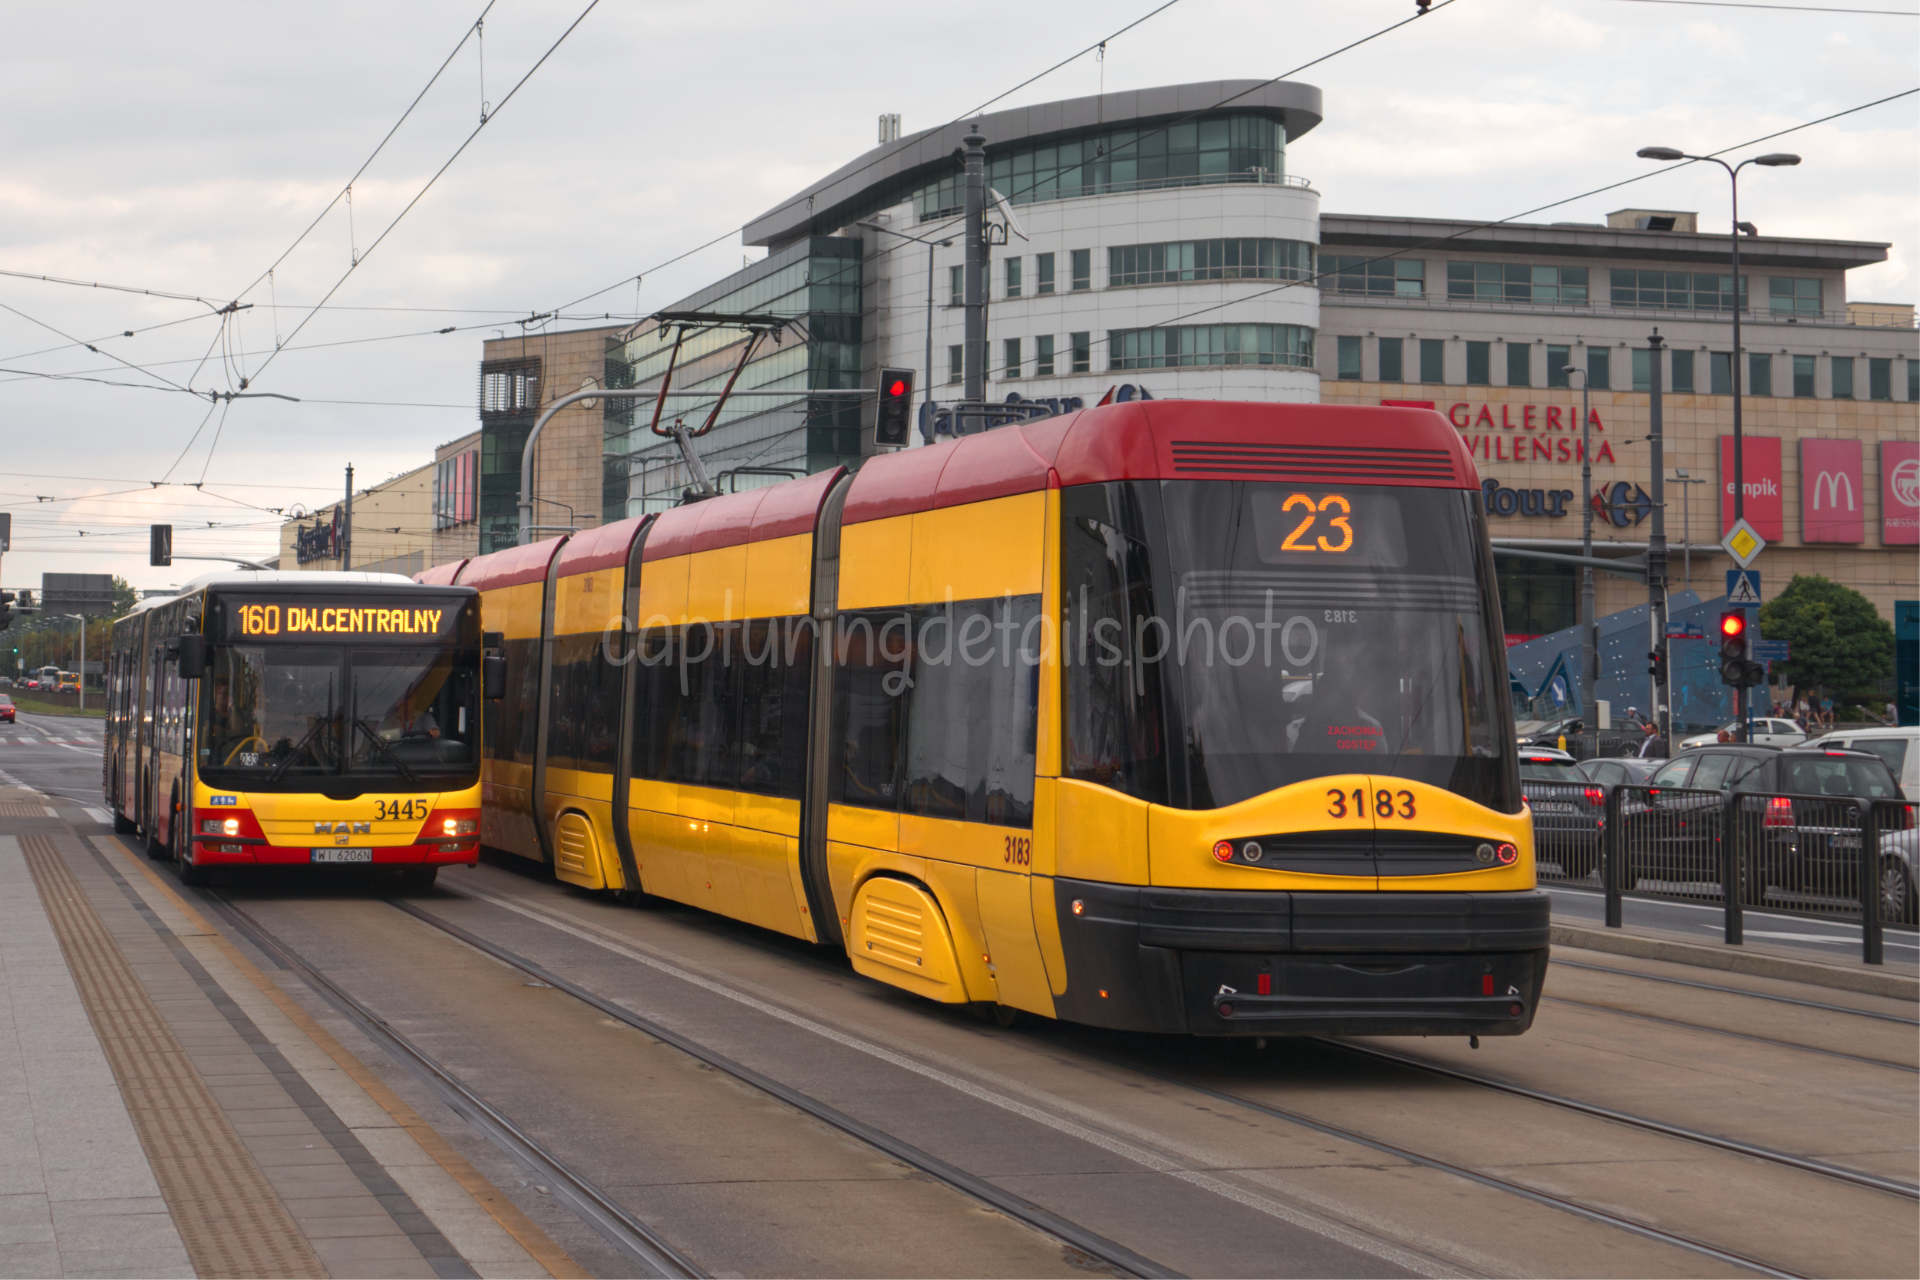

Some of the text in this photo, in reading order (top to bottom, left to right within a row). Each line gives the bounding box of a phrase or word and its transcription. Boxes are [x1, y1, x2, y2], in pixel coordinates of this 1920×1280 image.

[1450, 403, 1604, 431] GALERIA
[1281, 494, 1352, 552] 23
[238, 605, 442, 634] 160 DW.CENTRALNY
[375, 799, 428, 821] 3445
[1327, 789, 1417, 820] 3183
[315, 821, 371, 834] MAN
[318, 849, 332, 860] WI
[1004, 835, 1030, 866] 3183
